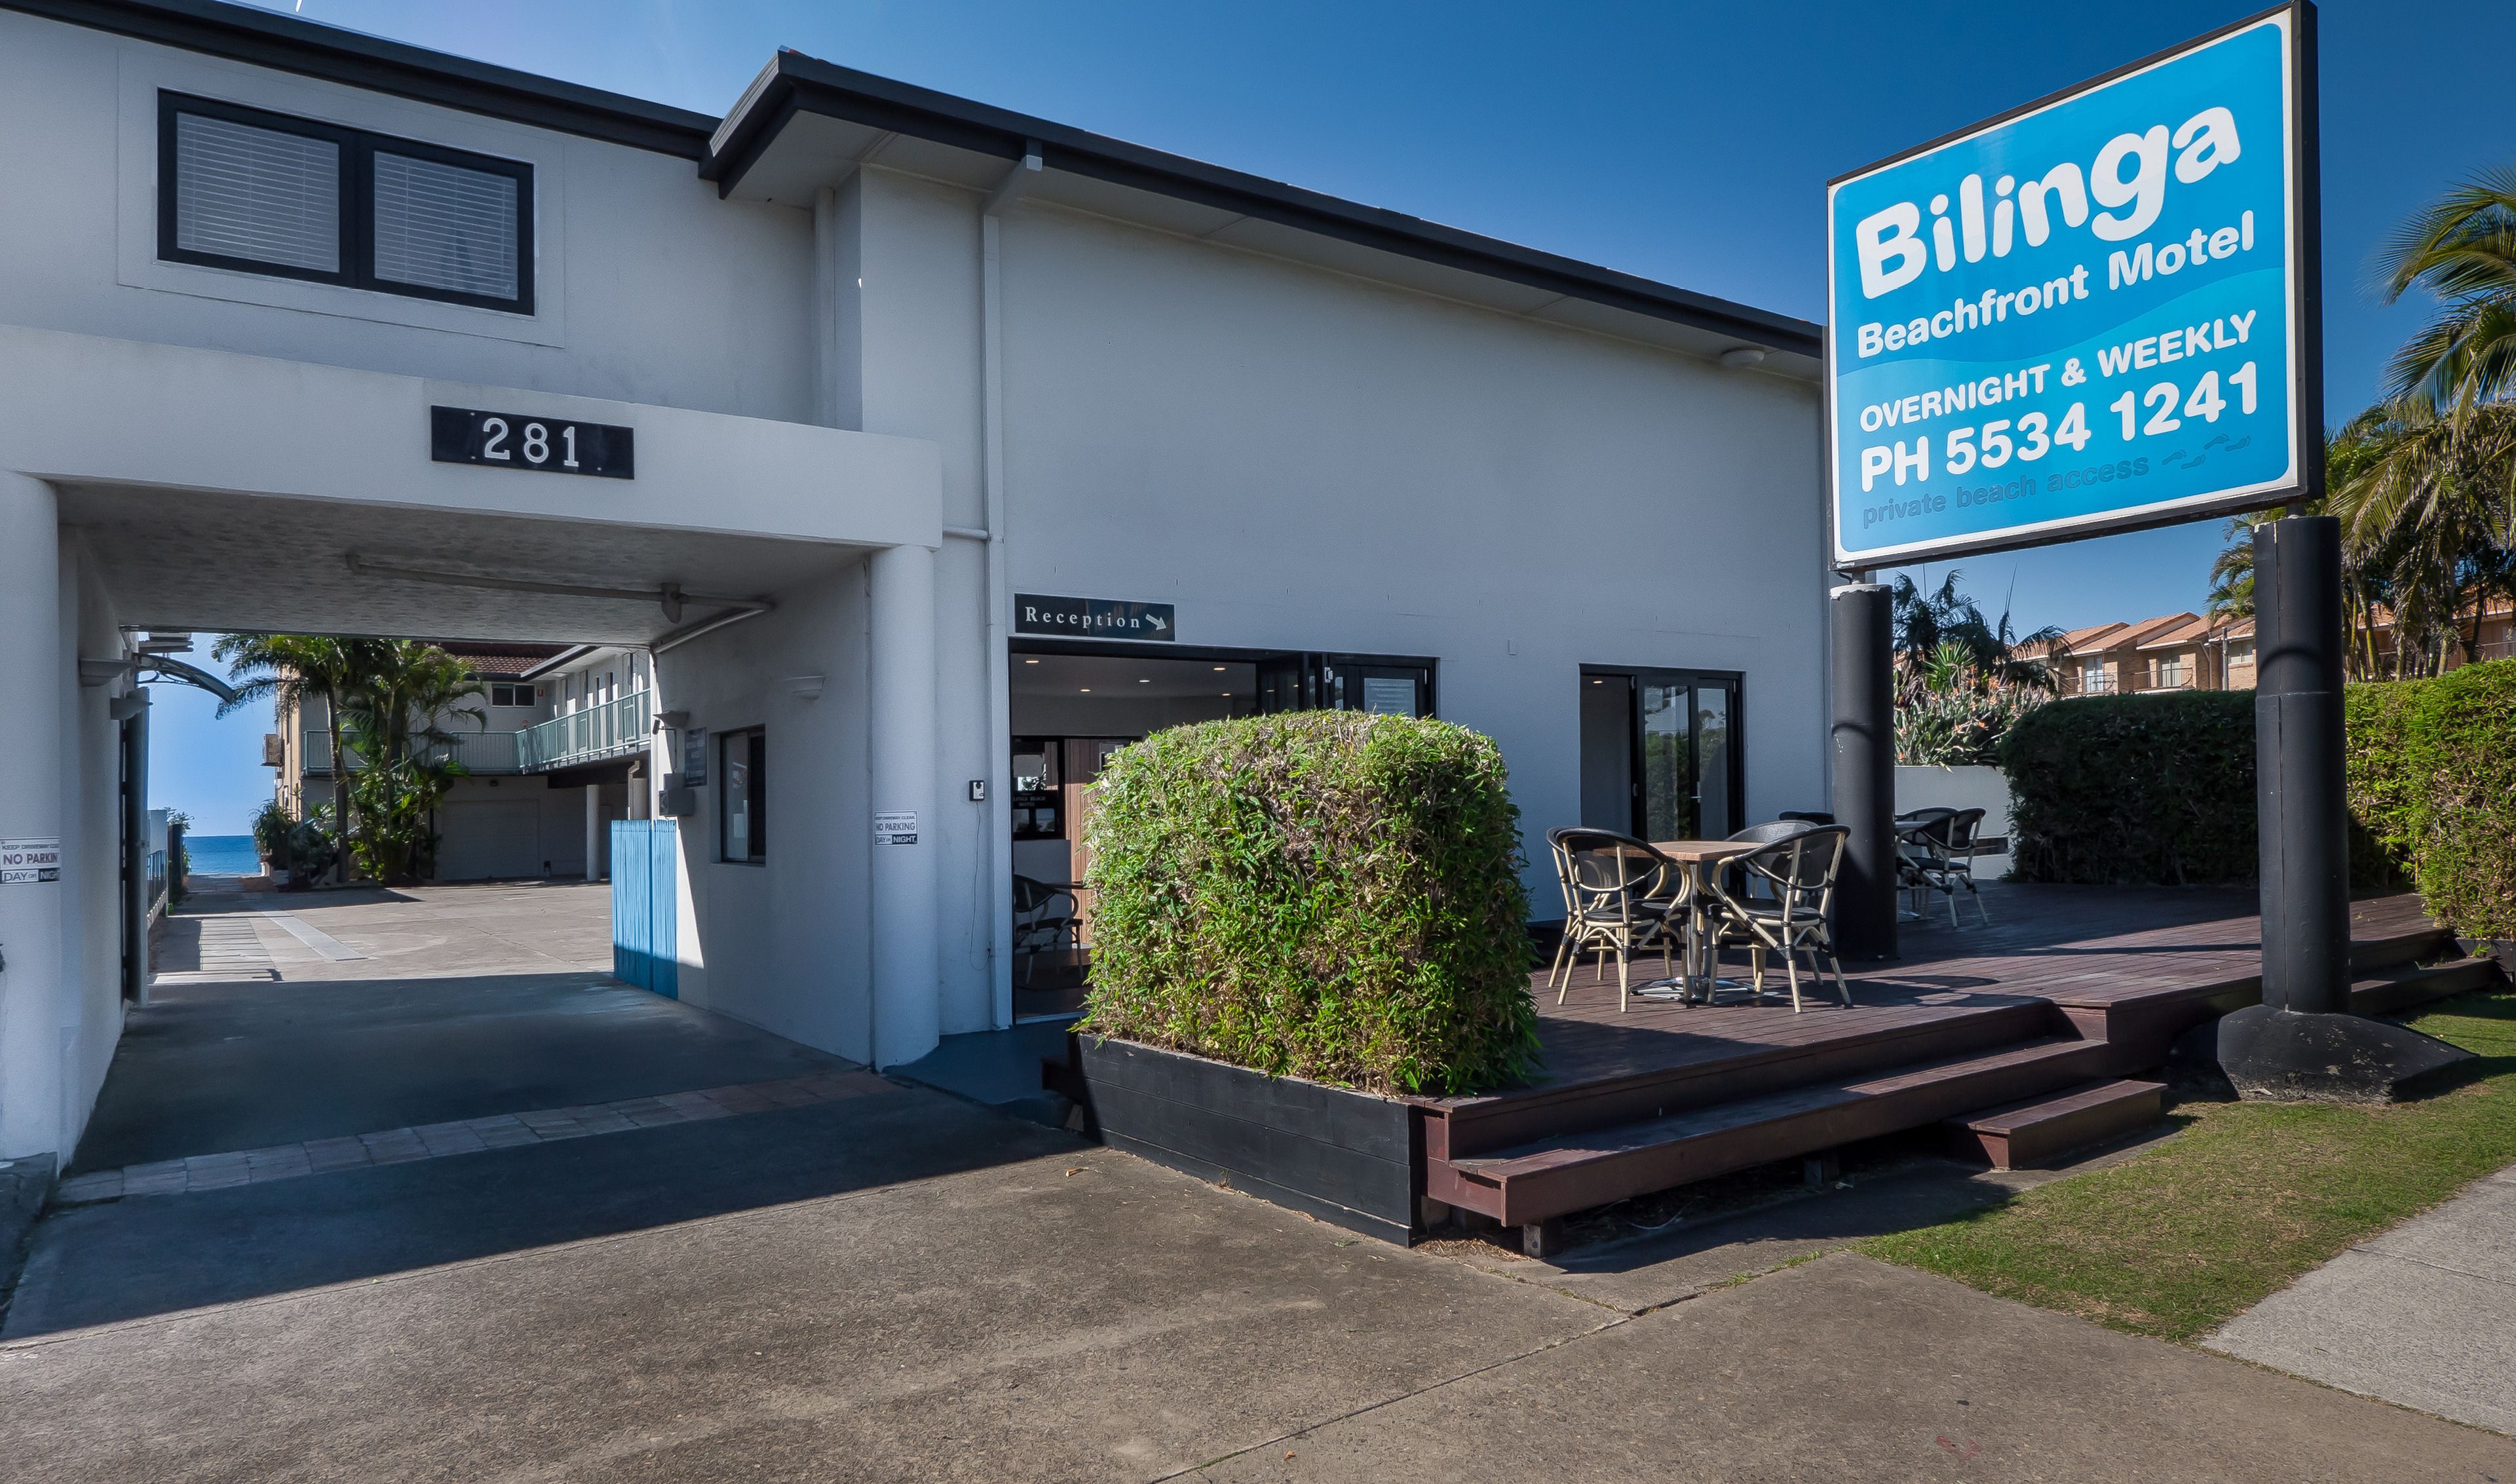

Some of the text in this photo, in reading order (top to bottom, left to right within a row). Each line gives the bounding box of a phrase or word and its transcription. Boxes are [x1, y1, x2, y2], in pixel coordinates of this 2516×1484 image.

[1855, 106, 2241, 300] Bilinga
[1857, 209, 2255, 359] Beachfront Motel
[1859, 309, 2257, 433] OVERNIGHT & WEEKLY
[482, 417, 580, 468] 281
[1860, 360, 2258, 493] PH 5534 1241
[1862, 456, 2150, 529] private beach access
[1025, 606, 1141, 629] Reception
[885, 822, 916, 831] PARKING
[3, 852, 58, 865] NO PARKIN
[4, 872, 28, 882] DAY
